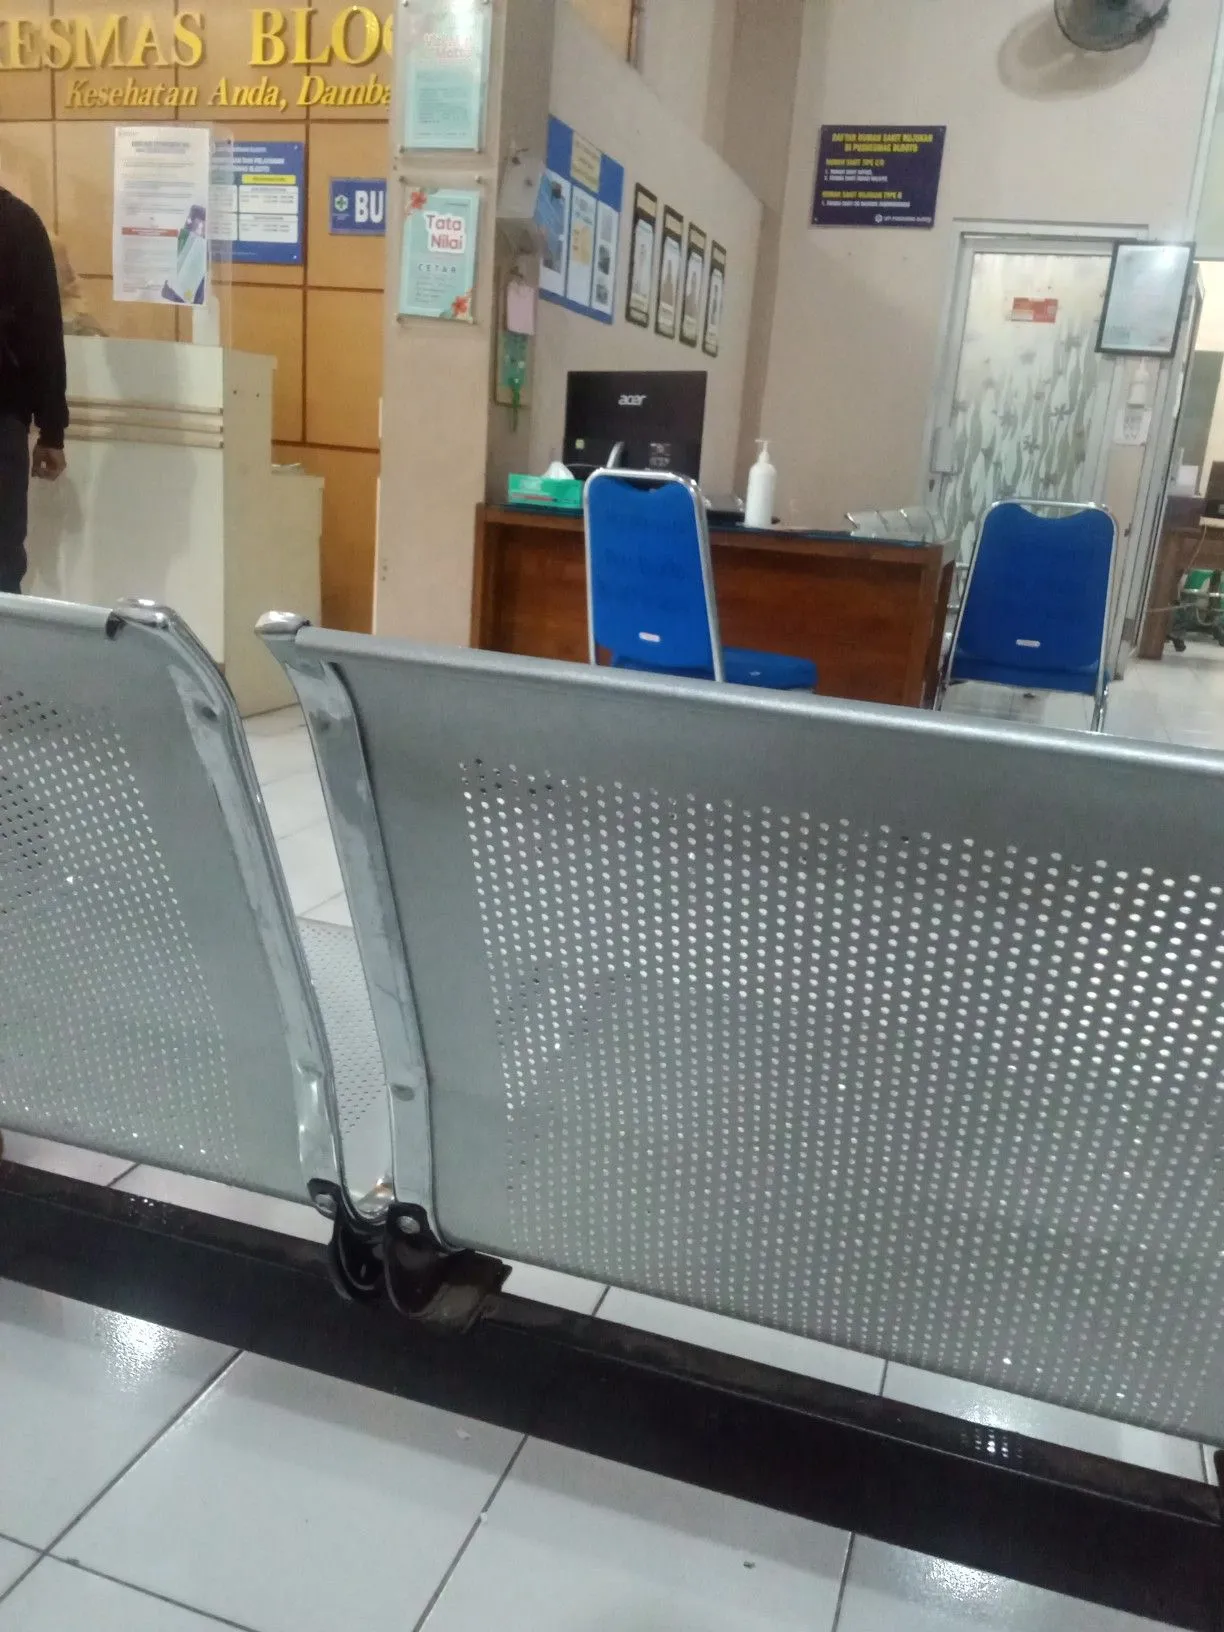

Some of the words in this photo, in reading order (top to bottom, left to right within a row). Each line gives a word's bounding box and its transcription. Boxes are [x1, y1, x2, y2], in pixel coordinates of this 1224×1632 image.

[65, 76, 198, 108] Kesehatan
[208, 76, 287, 111] Anda,
[426, 214, 462, 231] Tata
[430, 234, 463, 250] Nilai
[618, 394, 647, 406] acer
